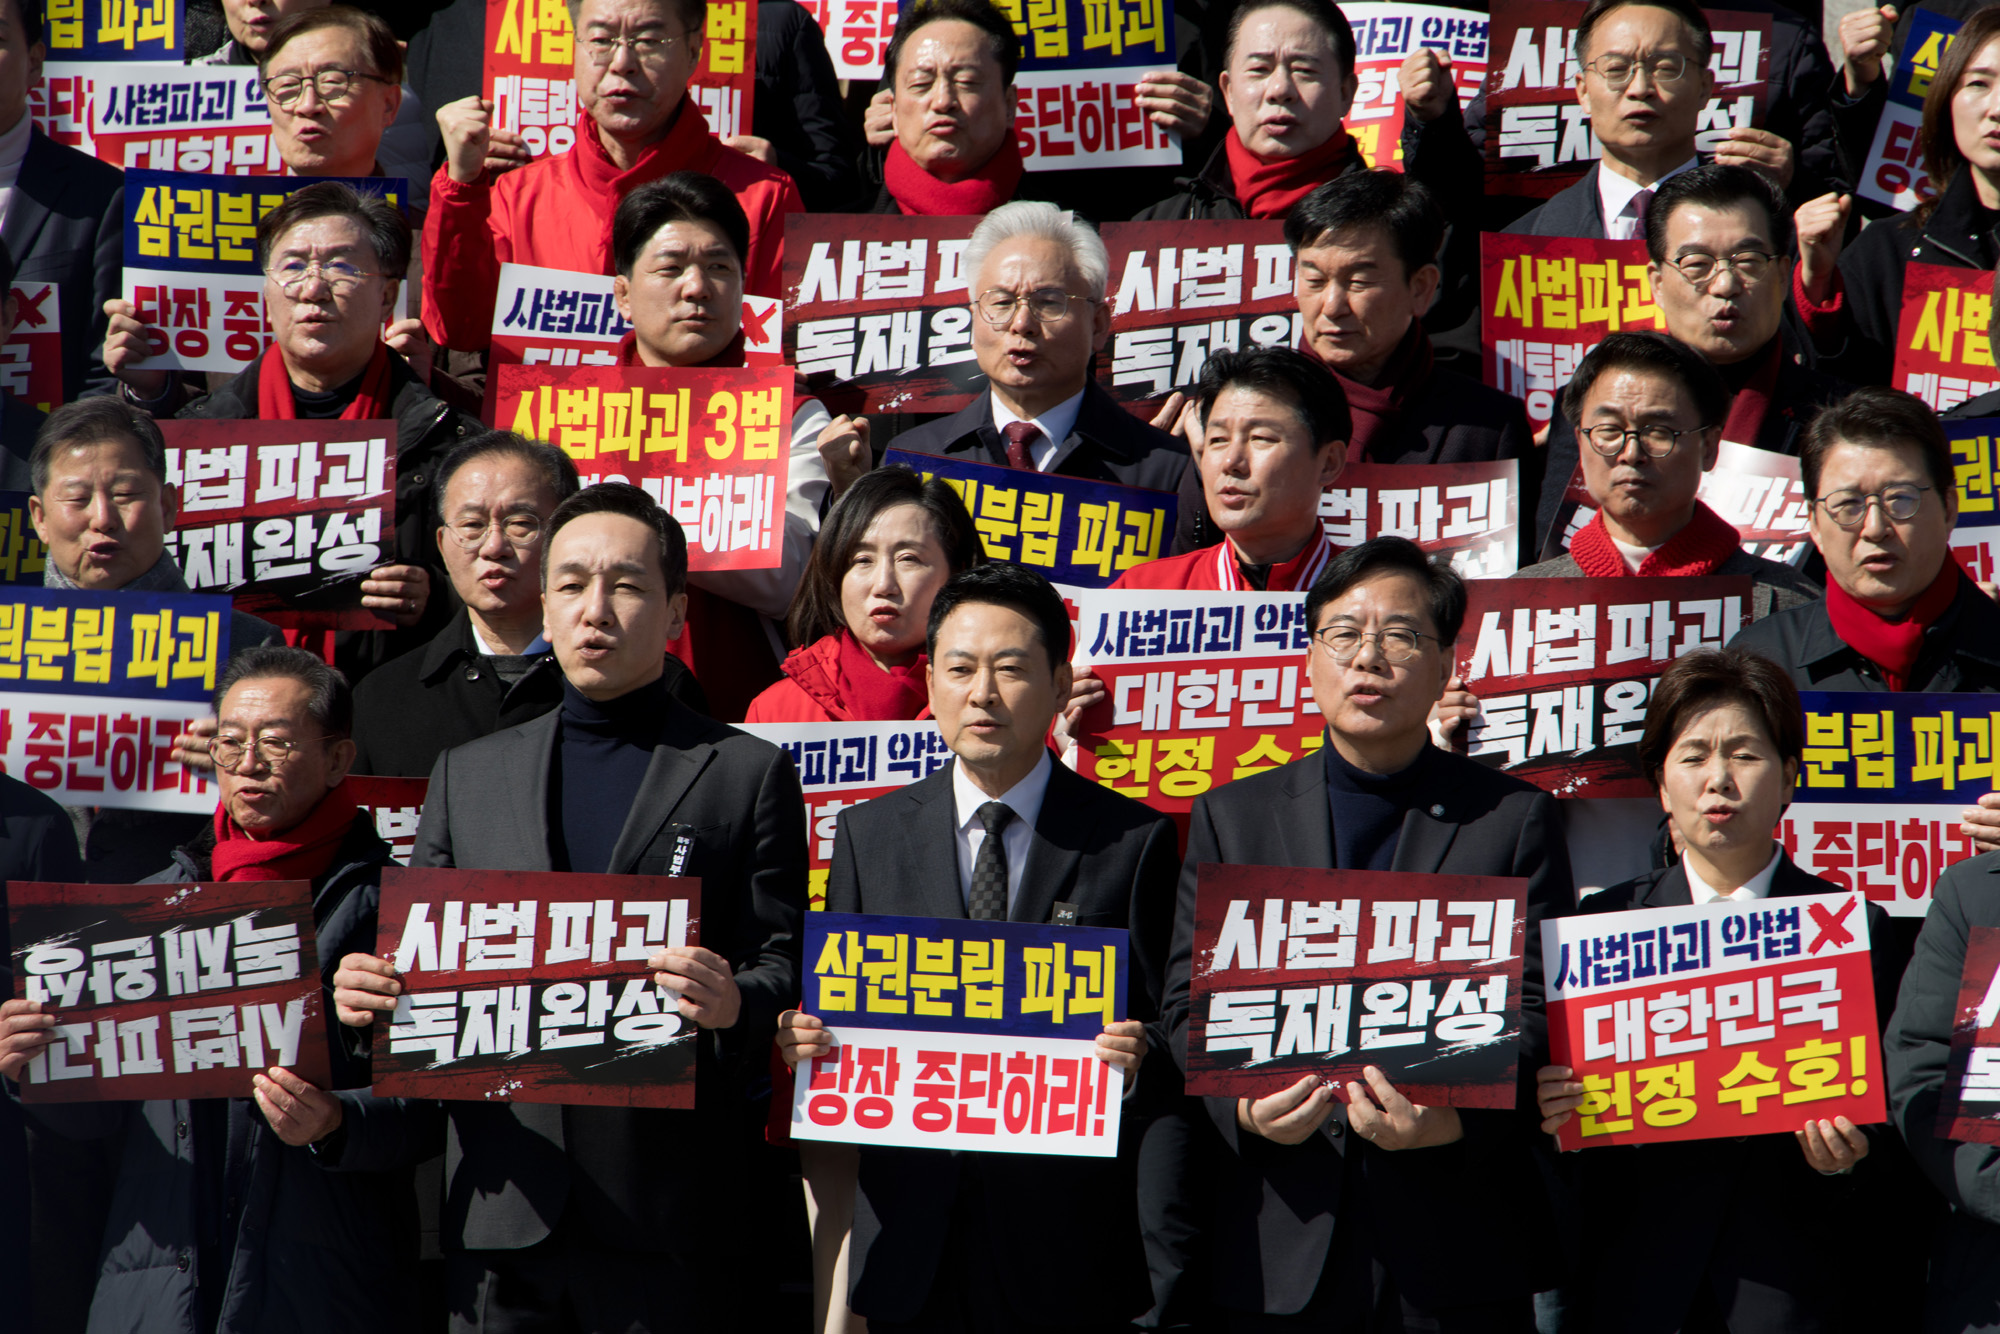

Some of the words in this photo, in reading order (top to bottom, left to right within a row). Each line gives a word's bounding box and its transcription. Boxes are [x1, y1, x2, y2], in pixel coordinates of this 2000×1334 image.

[1082, 0, 1167, 56] 파괴
[102, 79, 236, 126] 사법파괴
[800, 238, 928, 301] 사법
[1112, 243, 1244, 312] 사법
[133, 285, 210, 358] 당장
[795, 308, 922, 382] 독재
[511, 385, 691, 462] 사법파괴
[704, 387, 782, 461] 3법
[255, 438, 390, 503] 파괴
[252, 508, 382, 581] 완성
[1071, 500, 1165, 578] 파괴
[1377, 477, 1509, 542] 파괴
[127, 609, 219, 690] 파괴
[1089, 605, 1244, 657] 사법파괴
[1467, 604, 1597, 681] 사법
[1467, 685, 1596, 766] 독재
[1912, 711, 2000, 791] 파괴
[1094, 736, 1215, 798] 헌정
[162, 918, 301, 996] 독재
[392, 900, 538, 972] 사법
[545, 899, 689, 965] 파괴
[1209, 898, 1361, 970] 사법
[1367, 898, 1517, 965] 파괴
[1554, 919, 1711, 991] 사법파괴
[1721, 906, 1801, 962] 악법
[813, 931, 1005, 1020] 삼권분립
[1021, 942, 1116, 1026] 파괴
[1583, 967, 1842, 1064] 대한민국
[170, 1000, 306, 1074] 사법
[389, 984, 532, 1063] 독재
[539, 978, 683, 1051] 완성
[1205, 983, 1353, 1062] 독재
[1359, 974, 1510, 1051] 완성
[807, 1044, 900, 1130] 당장
[912, 1050, 1110, 1137] 중단하라!
[1575, 1060, 1698, 1138] 헌정
[1717, 1035, 1869, 1115] 수호!
